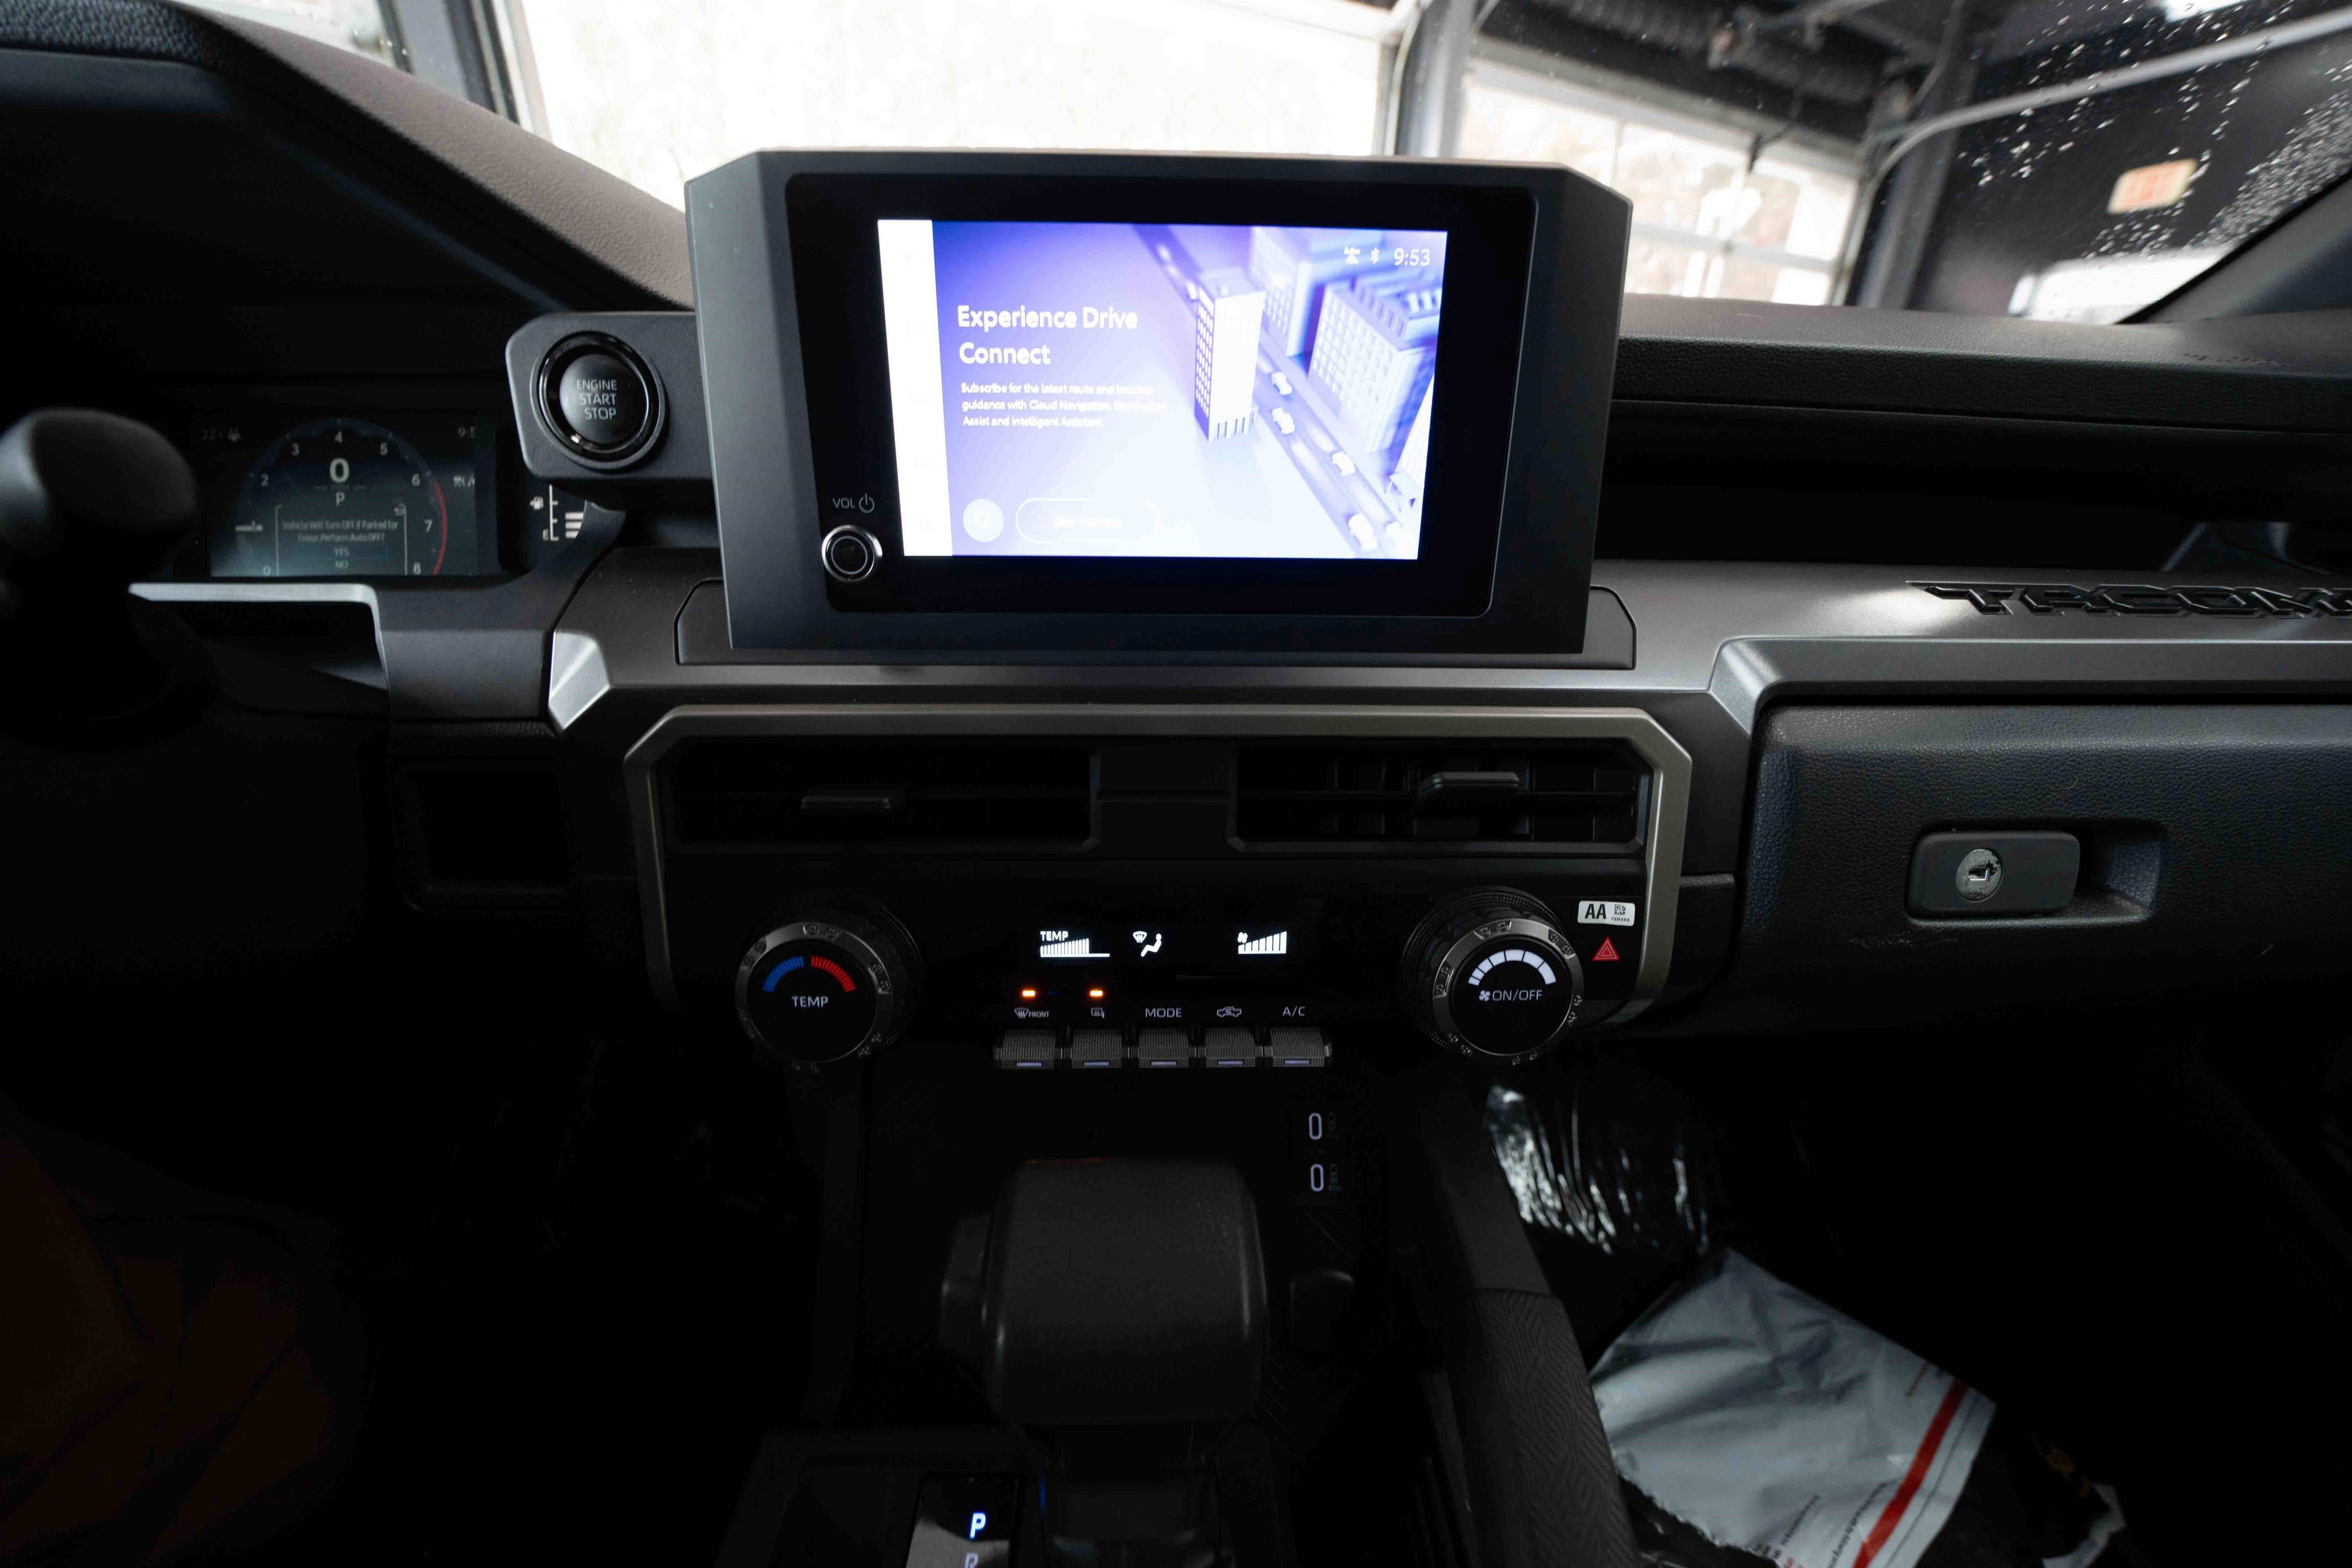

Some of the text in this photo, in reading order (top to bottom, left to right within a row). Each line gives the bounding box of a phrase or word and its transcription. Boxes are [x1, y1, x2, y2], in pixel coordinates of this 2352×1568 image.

[1394, 247, 1430, 266] 9:53
[958, 305, 1138, 332] Experience Drive
[959, 342, 1051, 364] Connect
[577, 379, 617, 390] ENGINE
[961, 382, 1007, 393] Subscribe
[1008, 382, 1022, 393] for
[1024, 382, 1040, 394] the
[579, 393, 617, 405] START
[962, 399, 1005, 412] guidance
[1007, 399, 1027, 410] with
[1029, 399, 1058, 411] Cloud
[584, 408, 616, 420] STOP
[963, 415, 990, 427] Assist
[991, 416, 1010, 427] and
[334, 431, 343, 444] 4
[292, 442, 300, 456] 3
[380, 442, 388, 456] 5
[329, 458, 350, 483] 0
[261, 473, 269, 487] 2
[412, 473, 421, 487] 6
[336, 492, 345, 506] P
[832, 497, 856, 509] VOL
[424, 519, 433, 532] 7
[334, 548, 350, 557] YES
[335, 561, 349, 570] NO
[413, 561, 422, 575] 8
[1584, 904, 1606, 919] AA
[1040, 931, 1068, 941] TEMP
[792, 996, 828, 1007] TEMP
[1492, 989, 1542, 1001] ON/OFF
[1145, 1008, 1182, 1018] MODE
[1282, 1006, 1305, 1017] A/C
[970, 1511, 986, 1539] P
